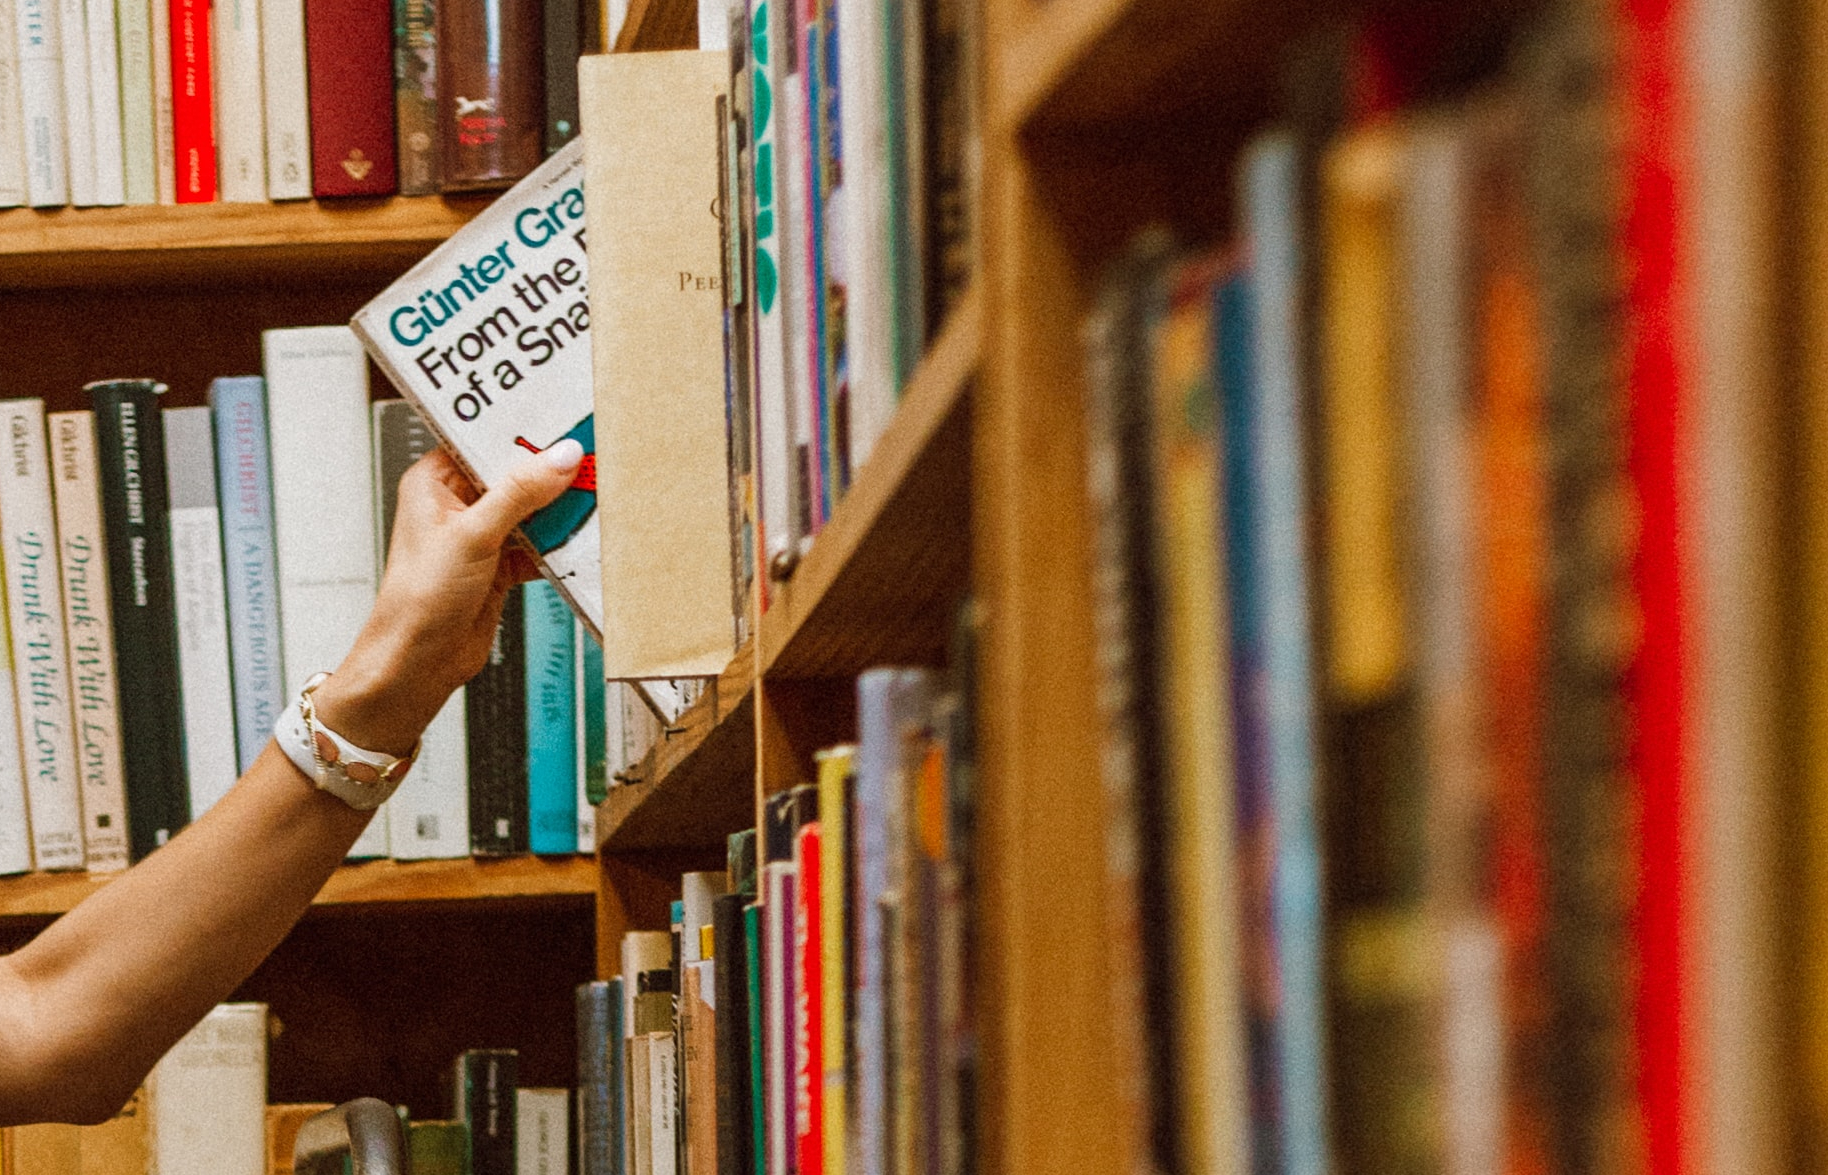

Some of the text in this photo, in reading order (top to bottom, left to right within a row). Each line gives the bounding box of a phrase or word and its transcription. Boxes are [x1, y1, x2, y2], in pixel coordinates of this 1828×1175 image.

[389, 184, 585, 348] Günter Gra
[416, 257, 582, 390] From the
[452, 376, 494, 424] of
[493, 357, 524, 392] a
[119, 402, 145, 525] ELLEN GILCHRIST
[235, 401, 261, 518] GILCHRIST
[10, 414, 62, 783] Gilchrist Drunk With Love
[62, 536, 97, 626] Drunk
[244, 560, 272, 691] DANGEROUS
[74, 636, 107, 711] With
[254, 697, 274, 740] AGE
[83, 720, 112, 787] Love
